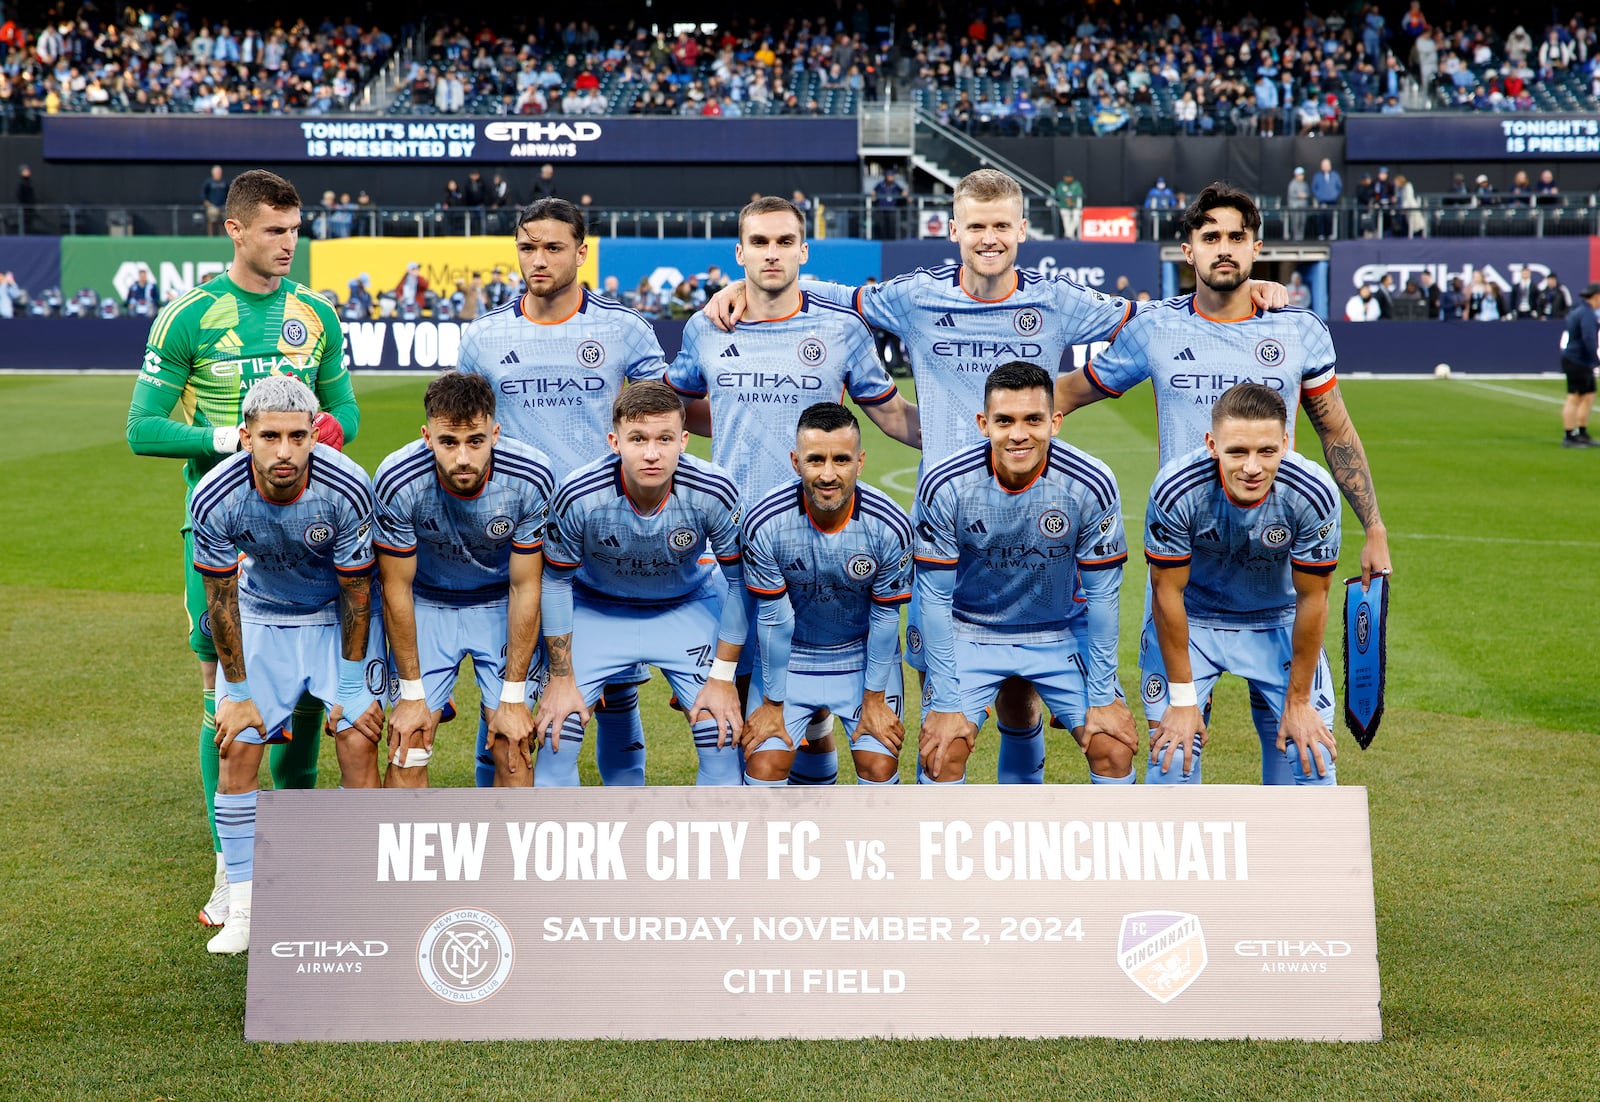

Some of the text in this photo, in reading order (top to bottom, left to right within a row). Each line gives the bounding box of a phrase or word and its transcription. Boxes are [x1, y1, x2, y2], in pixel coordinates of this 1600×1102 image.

[302, 123, 475, 139] TONIGHT'S MATCH
[484, 121, 602, 141] ETIHAD
[1502, 120, 1598, 136] TONIGHT'S
[307, 141, 475, 157] IS PRESENTED BY
[510, 143, 577, 157] AIRWAYS
[1506, 137, 1526, 153] IS
[1083, 219, 1134, 237] EXIT
[1353, 262, 1573, 307] ETIHAD
[391, 321, 471, 367] YOR
[932, 342, 1042, 358] ETIHAD
[211, 355, 315, 377] ETIHAD
[956, 362, 1001, 373] AIRWA
[500, 377, 605, 395] ETIHAD
[716, 372, 823, 390] ETIHAD
[523, 396, 583, 409] AIRWAYS
[738, 392, 798, 404] AIRWAYS
[1106, 541, 1119, 555] tv
[1324, 546, 1339, 560] tv
[614, 568, 674, 577] AIRWAY
[984, 558, 1047, 571] AIRWAYS
[377, 822, 490, 881] NEW
[506, 821, 628, 881] YORK
[646, 820, 749, 881] CITY
[767, 820, 820, 881] FC
[919, 820, 974, 881] FC
[983, 820, 1249, 881] CINCINNATI
[433, 912, 500, 931] NEW YORK CITY
[1131, 921, 1147, 936] FC
[543, 917, 1086, 944] SATURDAY, NOVEMBER 2, 2024
[271, 940, 389, 958] ETIHAD
[1125, 918, 1196, 970] CINCINNATI
[1234, 940, 1352, 957] ETIHAD
[296, 962, 362, 974] AIRWAYS
[1261, 962, 1328, 973] AIRWAYS
[431, 979, 500, 1000] FOOTBALL CLUB
[723, 969, 906, 994] CITI FIELD
